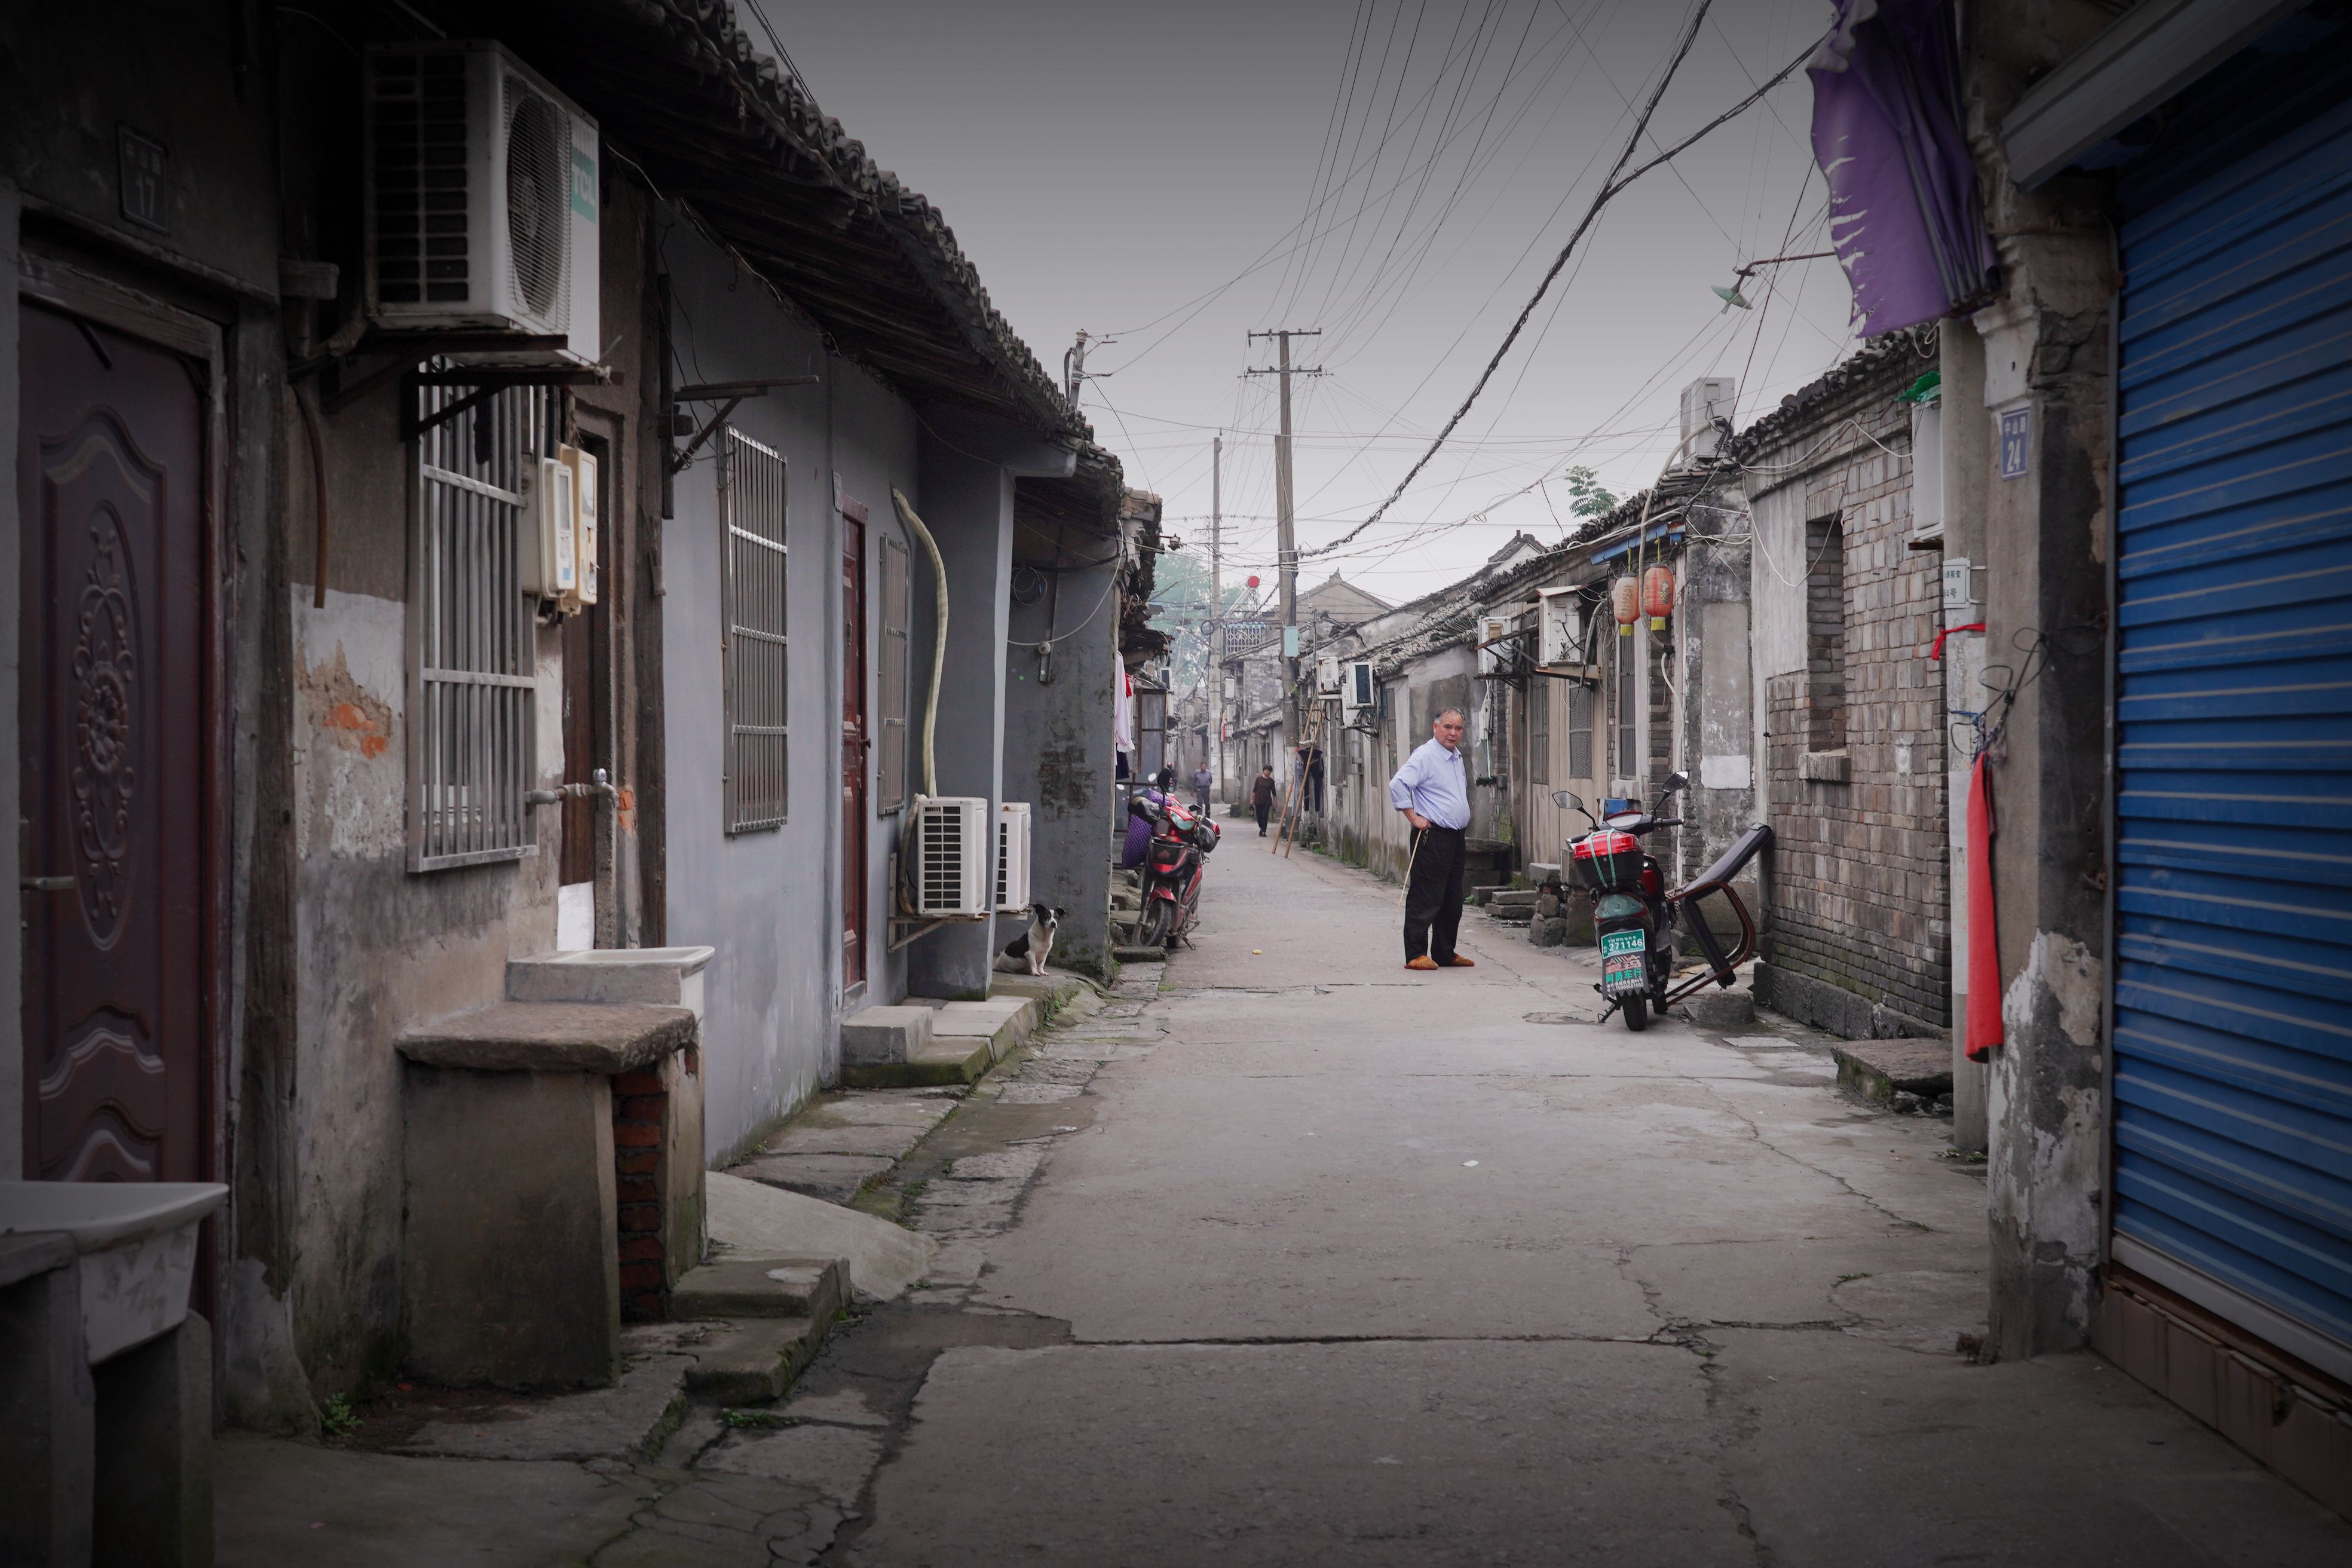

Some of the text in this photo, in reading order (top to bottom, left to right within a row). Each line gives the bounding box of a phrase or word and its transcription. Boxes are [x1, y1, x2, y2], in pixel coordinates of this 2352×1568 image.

[136, 173, 154, 219] 17
[571, 162, 596, 207] TCL
[2004, 416, 2026, 437] 中山路
[2007, 439, 2020, 472] 24
[1609, 938, 1643, 951] 271146
